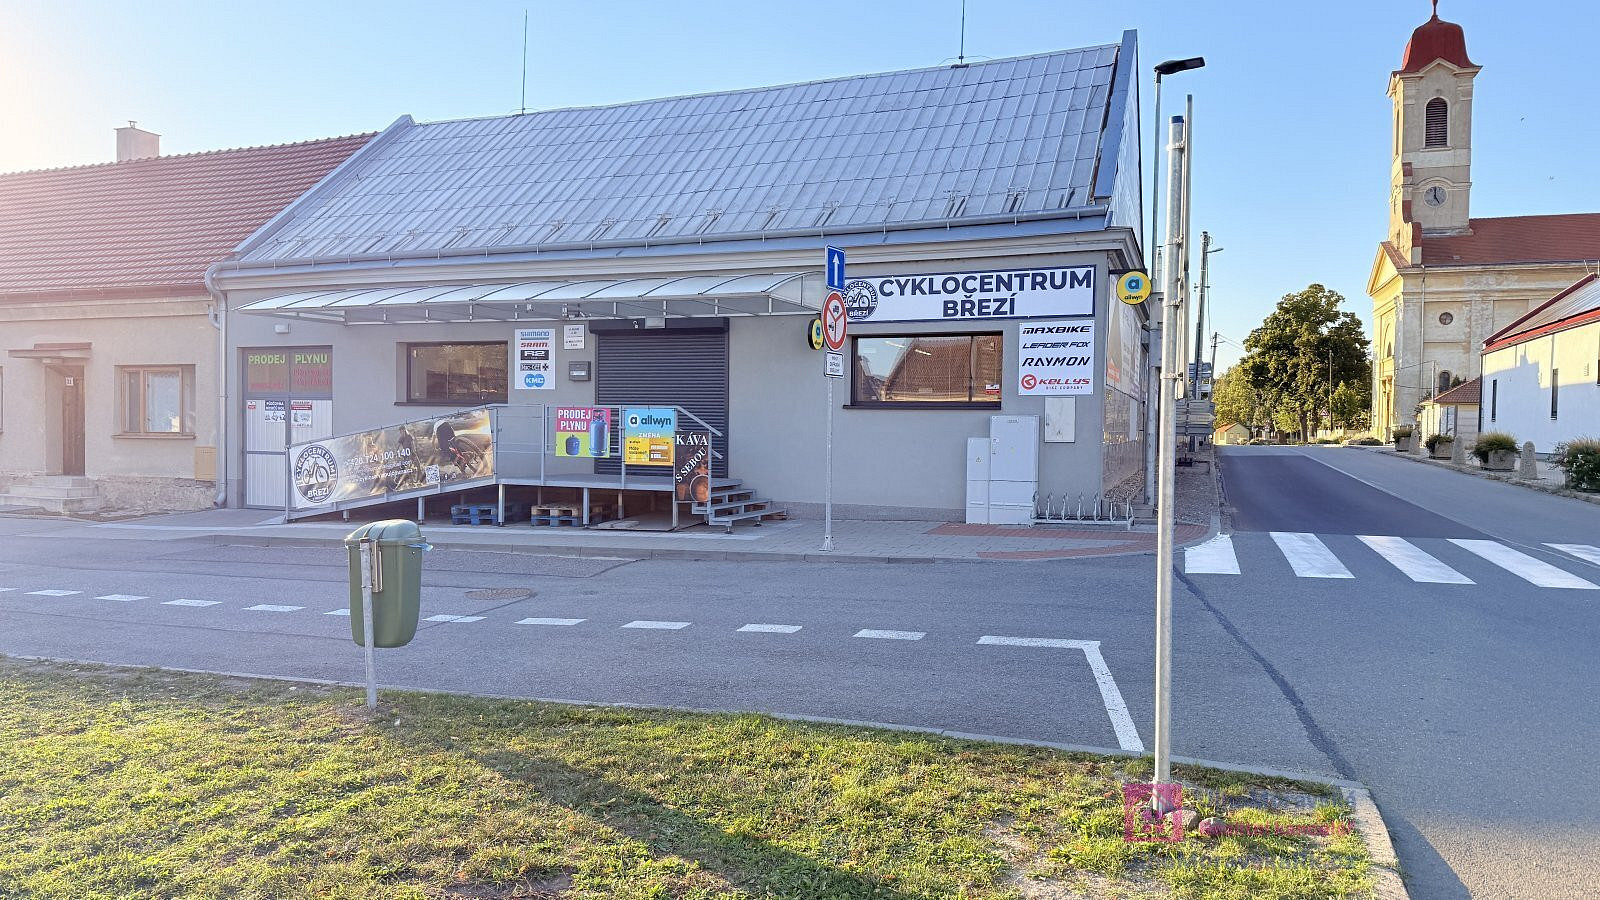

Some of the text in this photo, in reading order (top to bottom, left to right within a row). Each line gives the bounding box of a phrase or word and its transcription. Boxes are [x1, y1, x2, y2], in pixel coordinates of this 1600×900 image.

[878, 269, 1092, 297] CYKLOCENTRUM
[943, 292, 1017, 318] BŘEZÍ
[849, 308, 869, 317] BŘEZÍ
[1022, 325, 1092, 335] MAXBIKE
[1022, 341, 1069, 349] LEADER
[248, 353, 328, 365] PRODEJ PLYNU
[1022, 356, 1091, 367] RAYMON
[558, 409, 591, 420] PRODEJ
[560, 421, 587, 431] PLYNU
[641, 414, 672, 428] allwyn
[676, 431, 709, 446] KÁVA
[397, 447, 411, 458] 140
[296, 447, 336, 479] CYKLOCENTRUM
[675, 447, 708, 483] S SEBOU
[307, 485, 330, 498] BŘEZÍ
